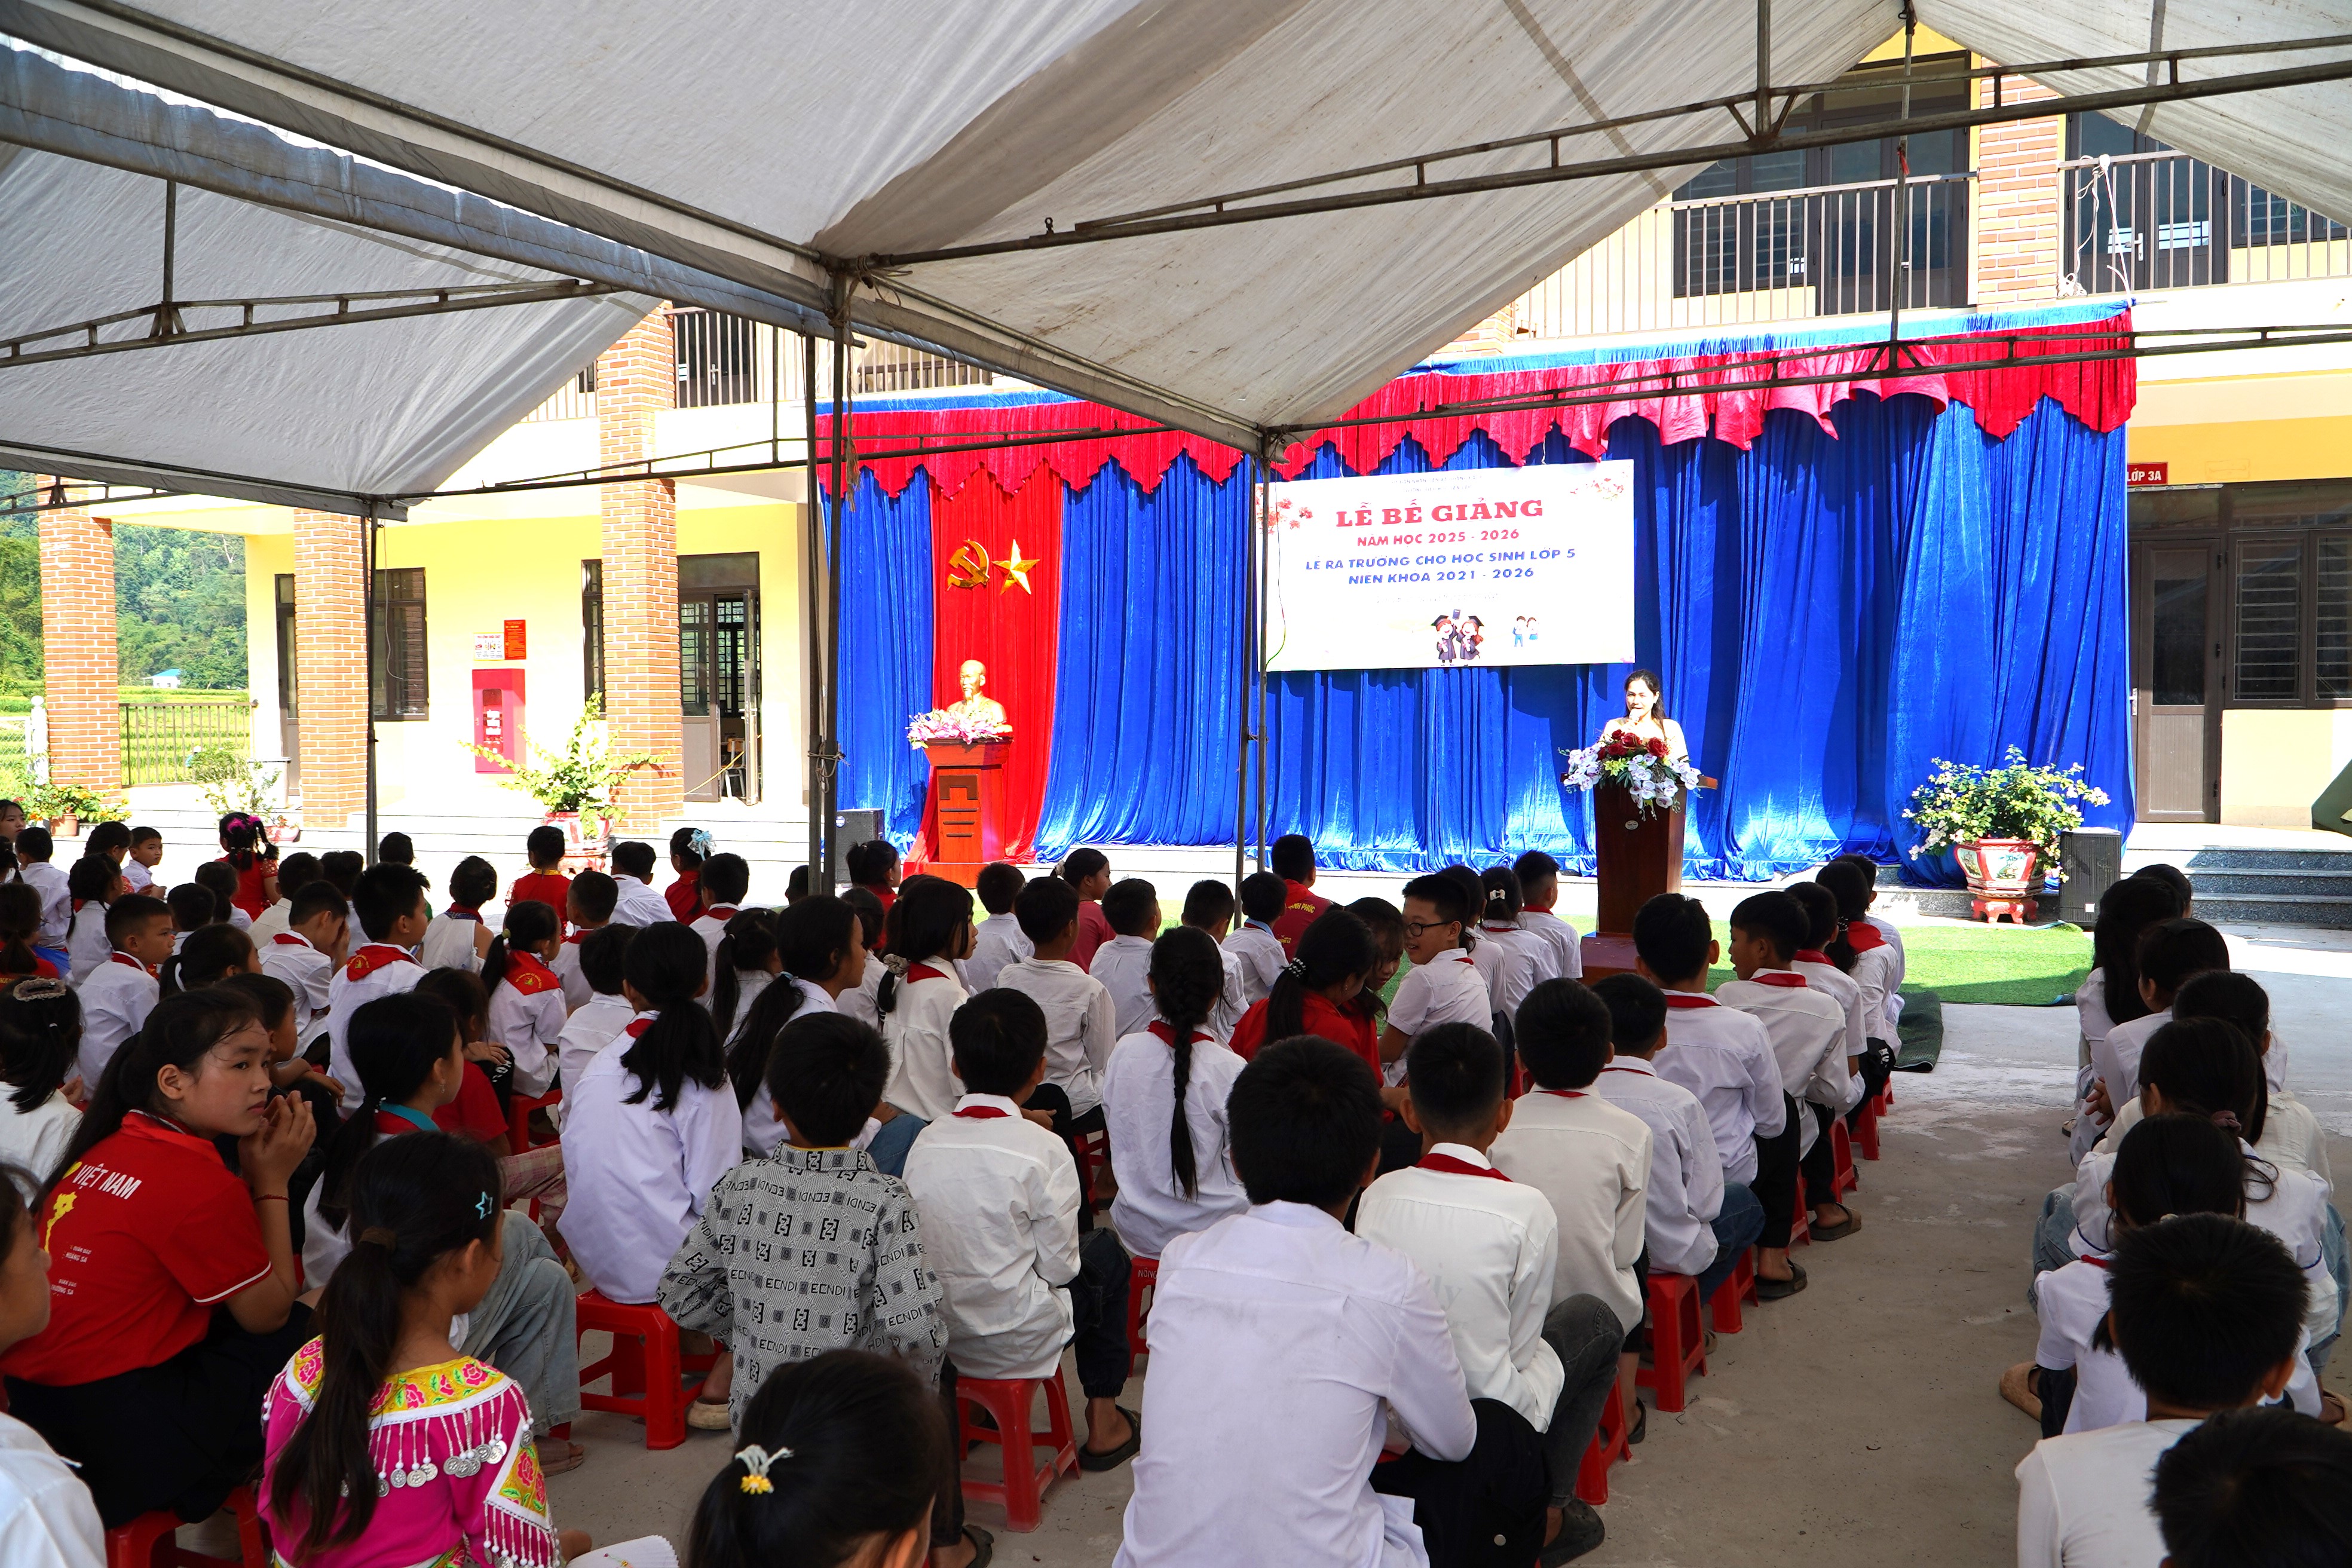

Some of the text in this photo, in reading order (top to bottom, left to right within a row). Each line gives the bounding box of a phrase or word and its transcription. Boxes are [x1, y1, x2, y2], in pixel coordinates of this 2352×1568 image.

[2148, 470, 2162, 481] 3A
[1336, 497, 1543, 527] LỄ BẾ GIẢNG
[1393, 534, 1423, 547] HỌC
[1428, 532, 1466, 543] 2025
[1481, 529, 1520, 541] 2026
[1325, 560, 1344, 569] RA
[1416, 555, 1447, 565] CHO
[1451, 553, 1484, 566] HỌC
[1489, 552, 1525, 562] SINH
[1530, 547, 1561, 559] LỚP
[1566, 549, 1576, 558] 5
[1437, 570, 1475, 581] 2021
[1492, 568, 1534, 578] 2026
[72, 1163, 142, 1200] VIỆT NAM
